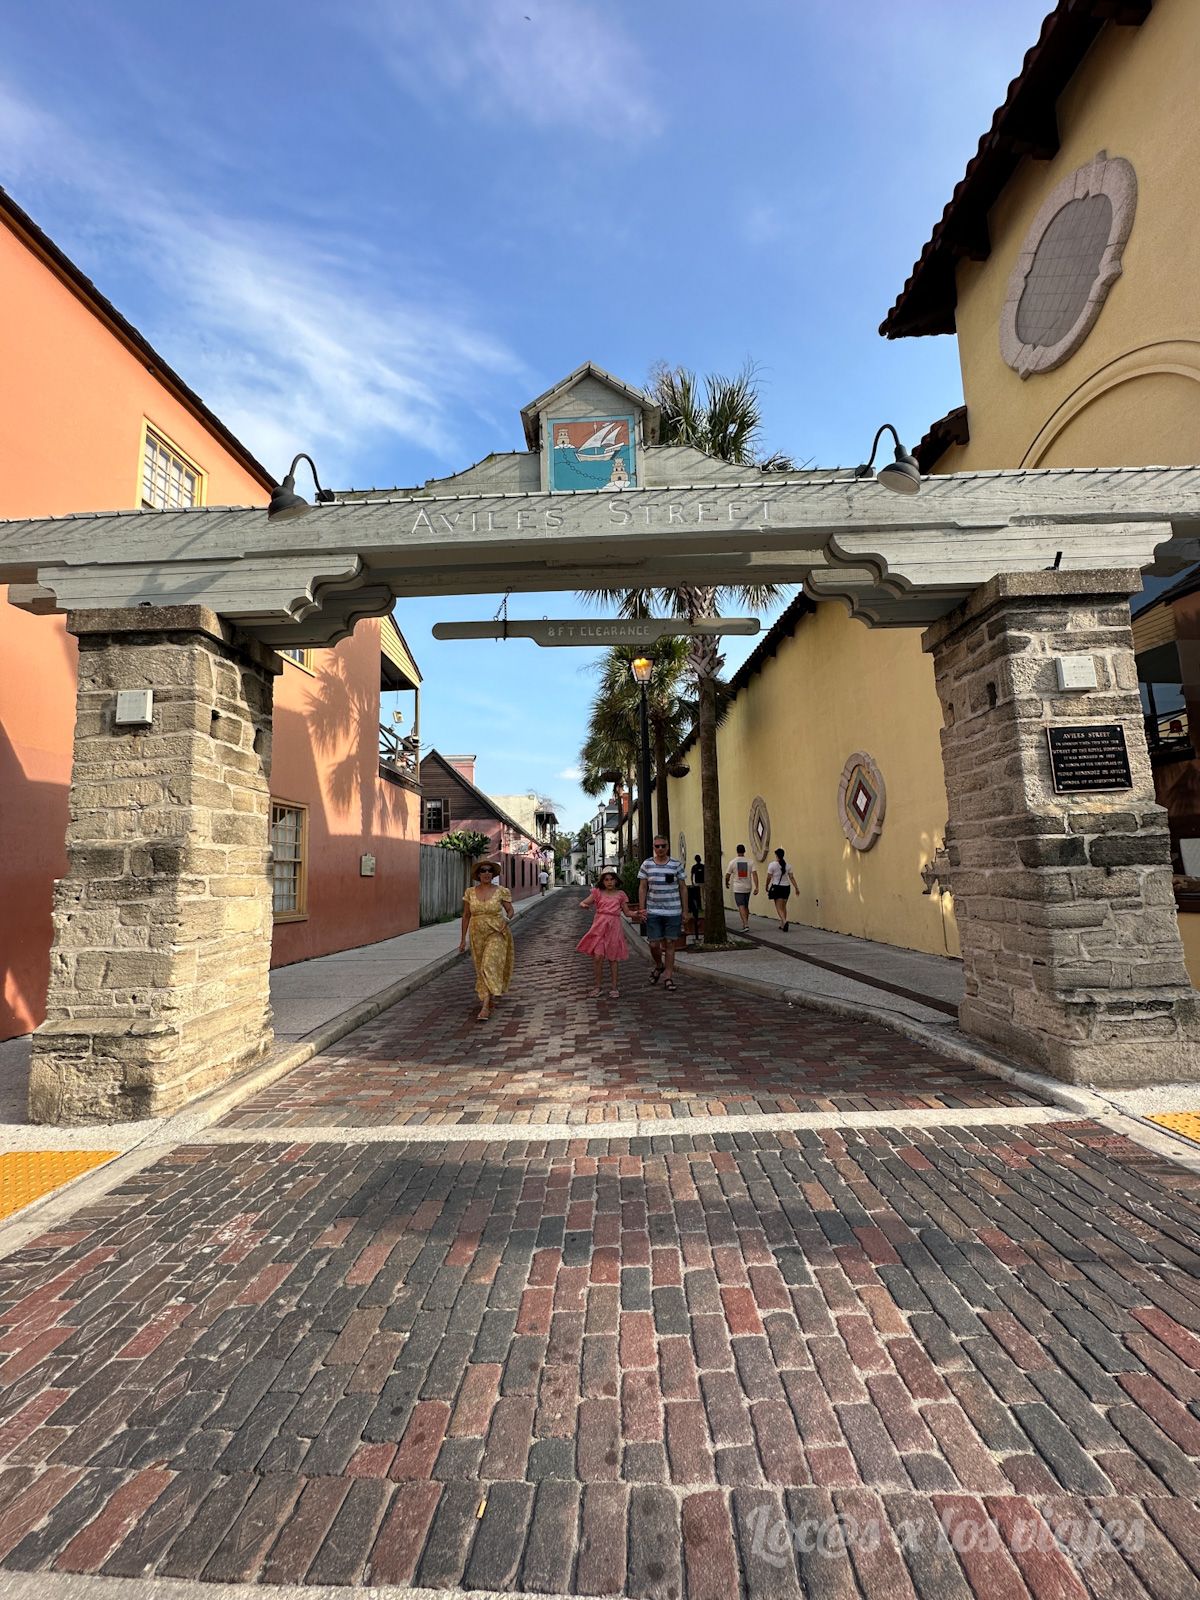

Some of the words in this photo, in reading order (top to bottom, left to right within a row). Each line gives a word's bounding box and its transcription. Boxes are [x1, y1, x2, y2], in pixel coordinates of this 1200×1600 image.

[410, 506, 564, 535] AVILES
[608, 499, 778, 526] STREET
[580, 625, 650, 637] CLEARANCE
